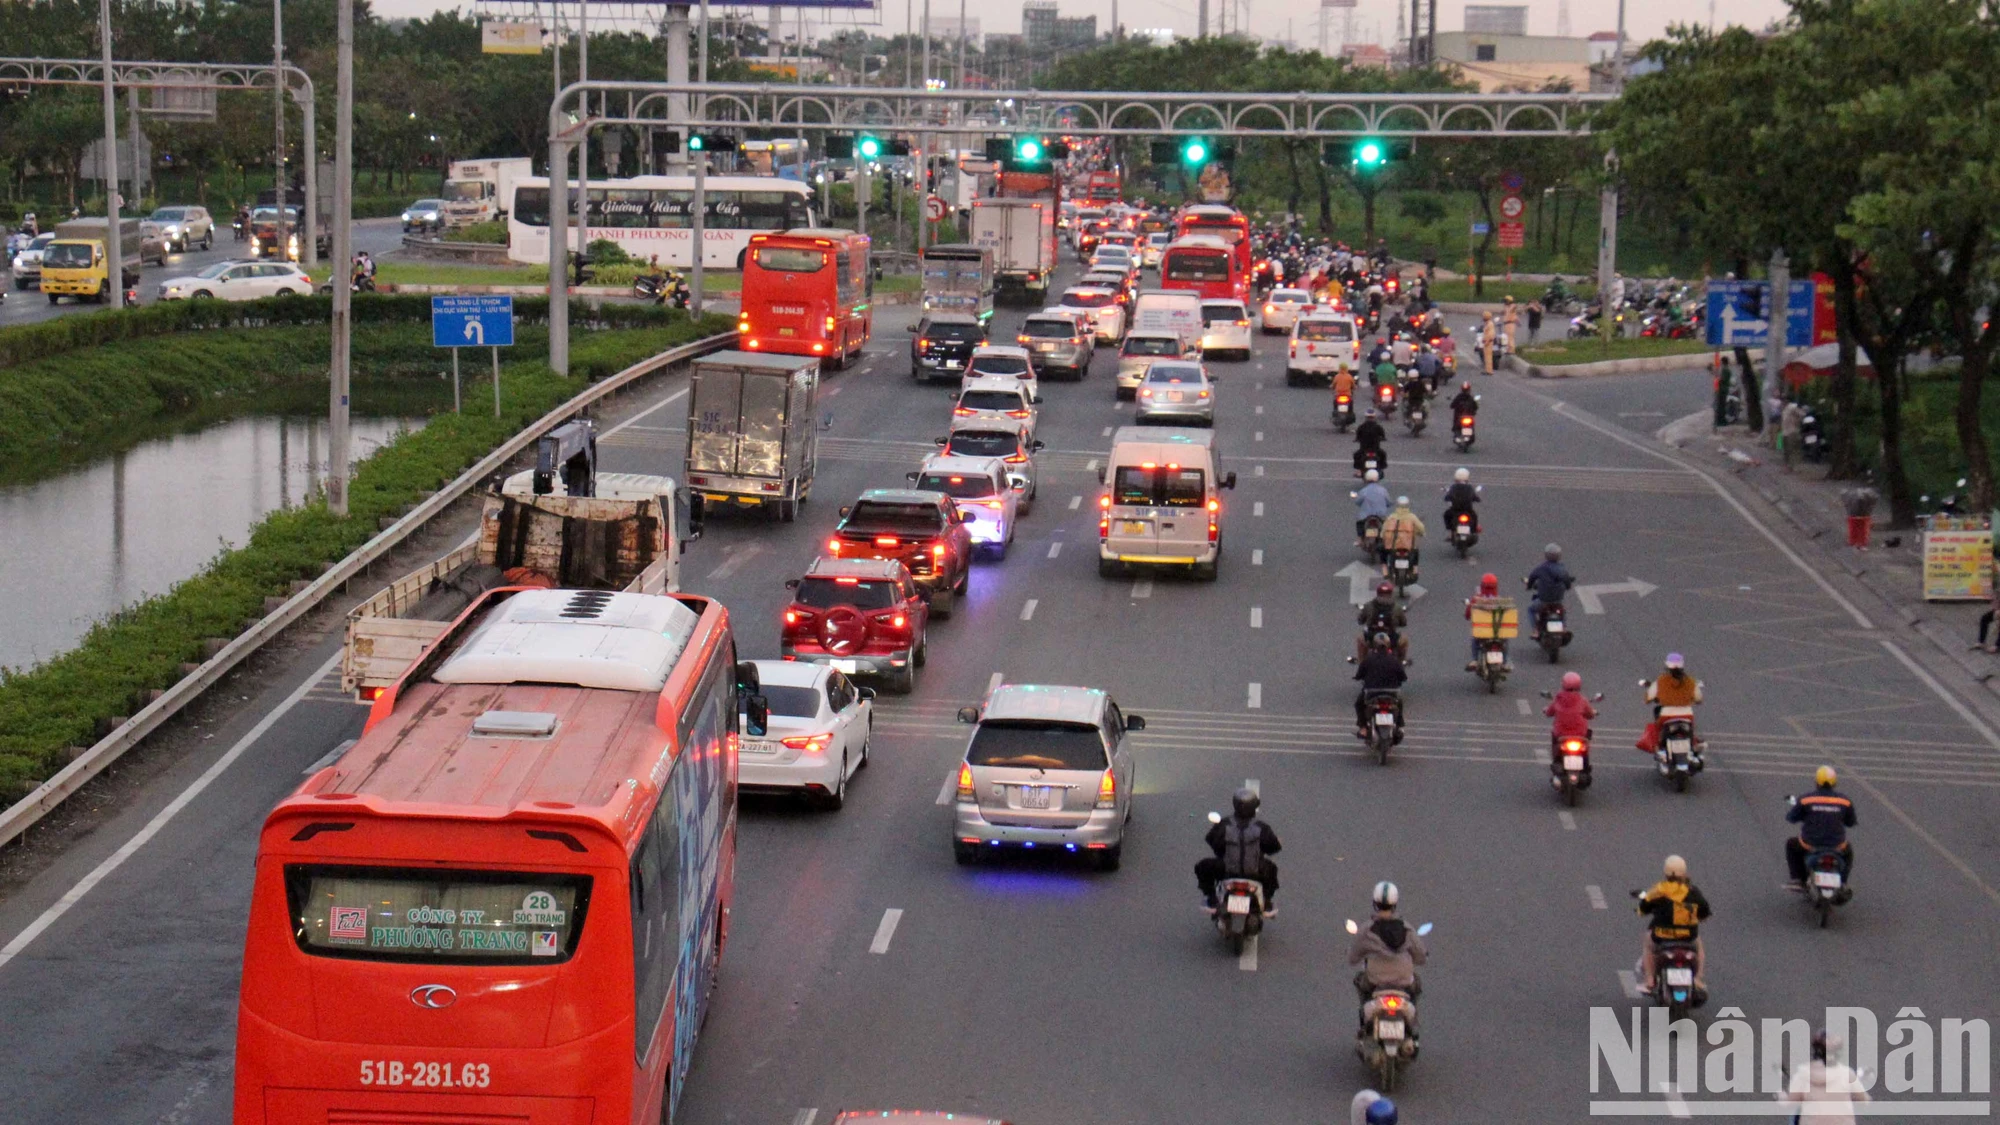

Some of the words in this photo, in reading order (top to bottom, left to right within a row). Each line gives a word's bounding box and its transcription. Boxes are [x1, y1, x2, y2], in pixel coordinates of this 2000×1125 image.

[585, 230, 625, 239] HANH
[529, 895, 550, 909] 28
[407, 904, 456, 924] CÔNG
[460, 910, 485, 925] TY
[514, 911, 532, 923] SÓC
[372, 925, 454, 950] PHƯƠNG
[459, 930, 528, 951] TRANG
[360, 1060, 490, 1088] 51B-281.63
